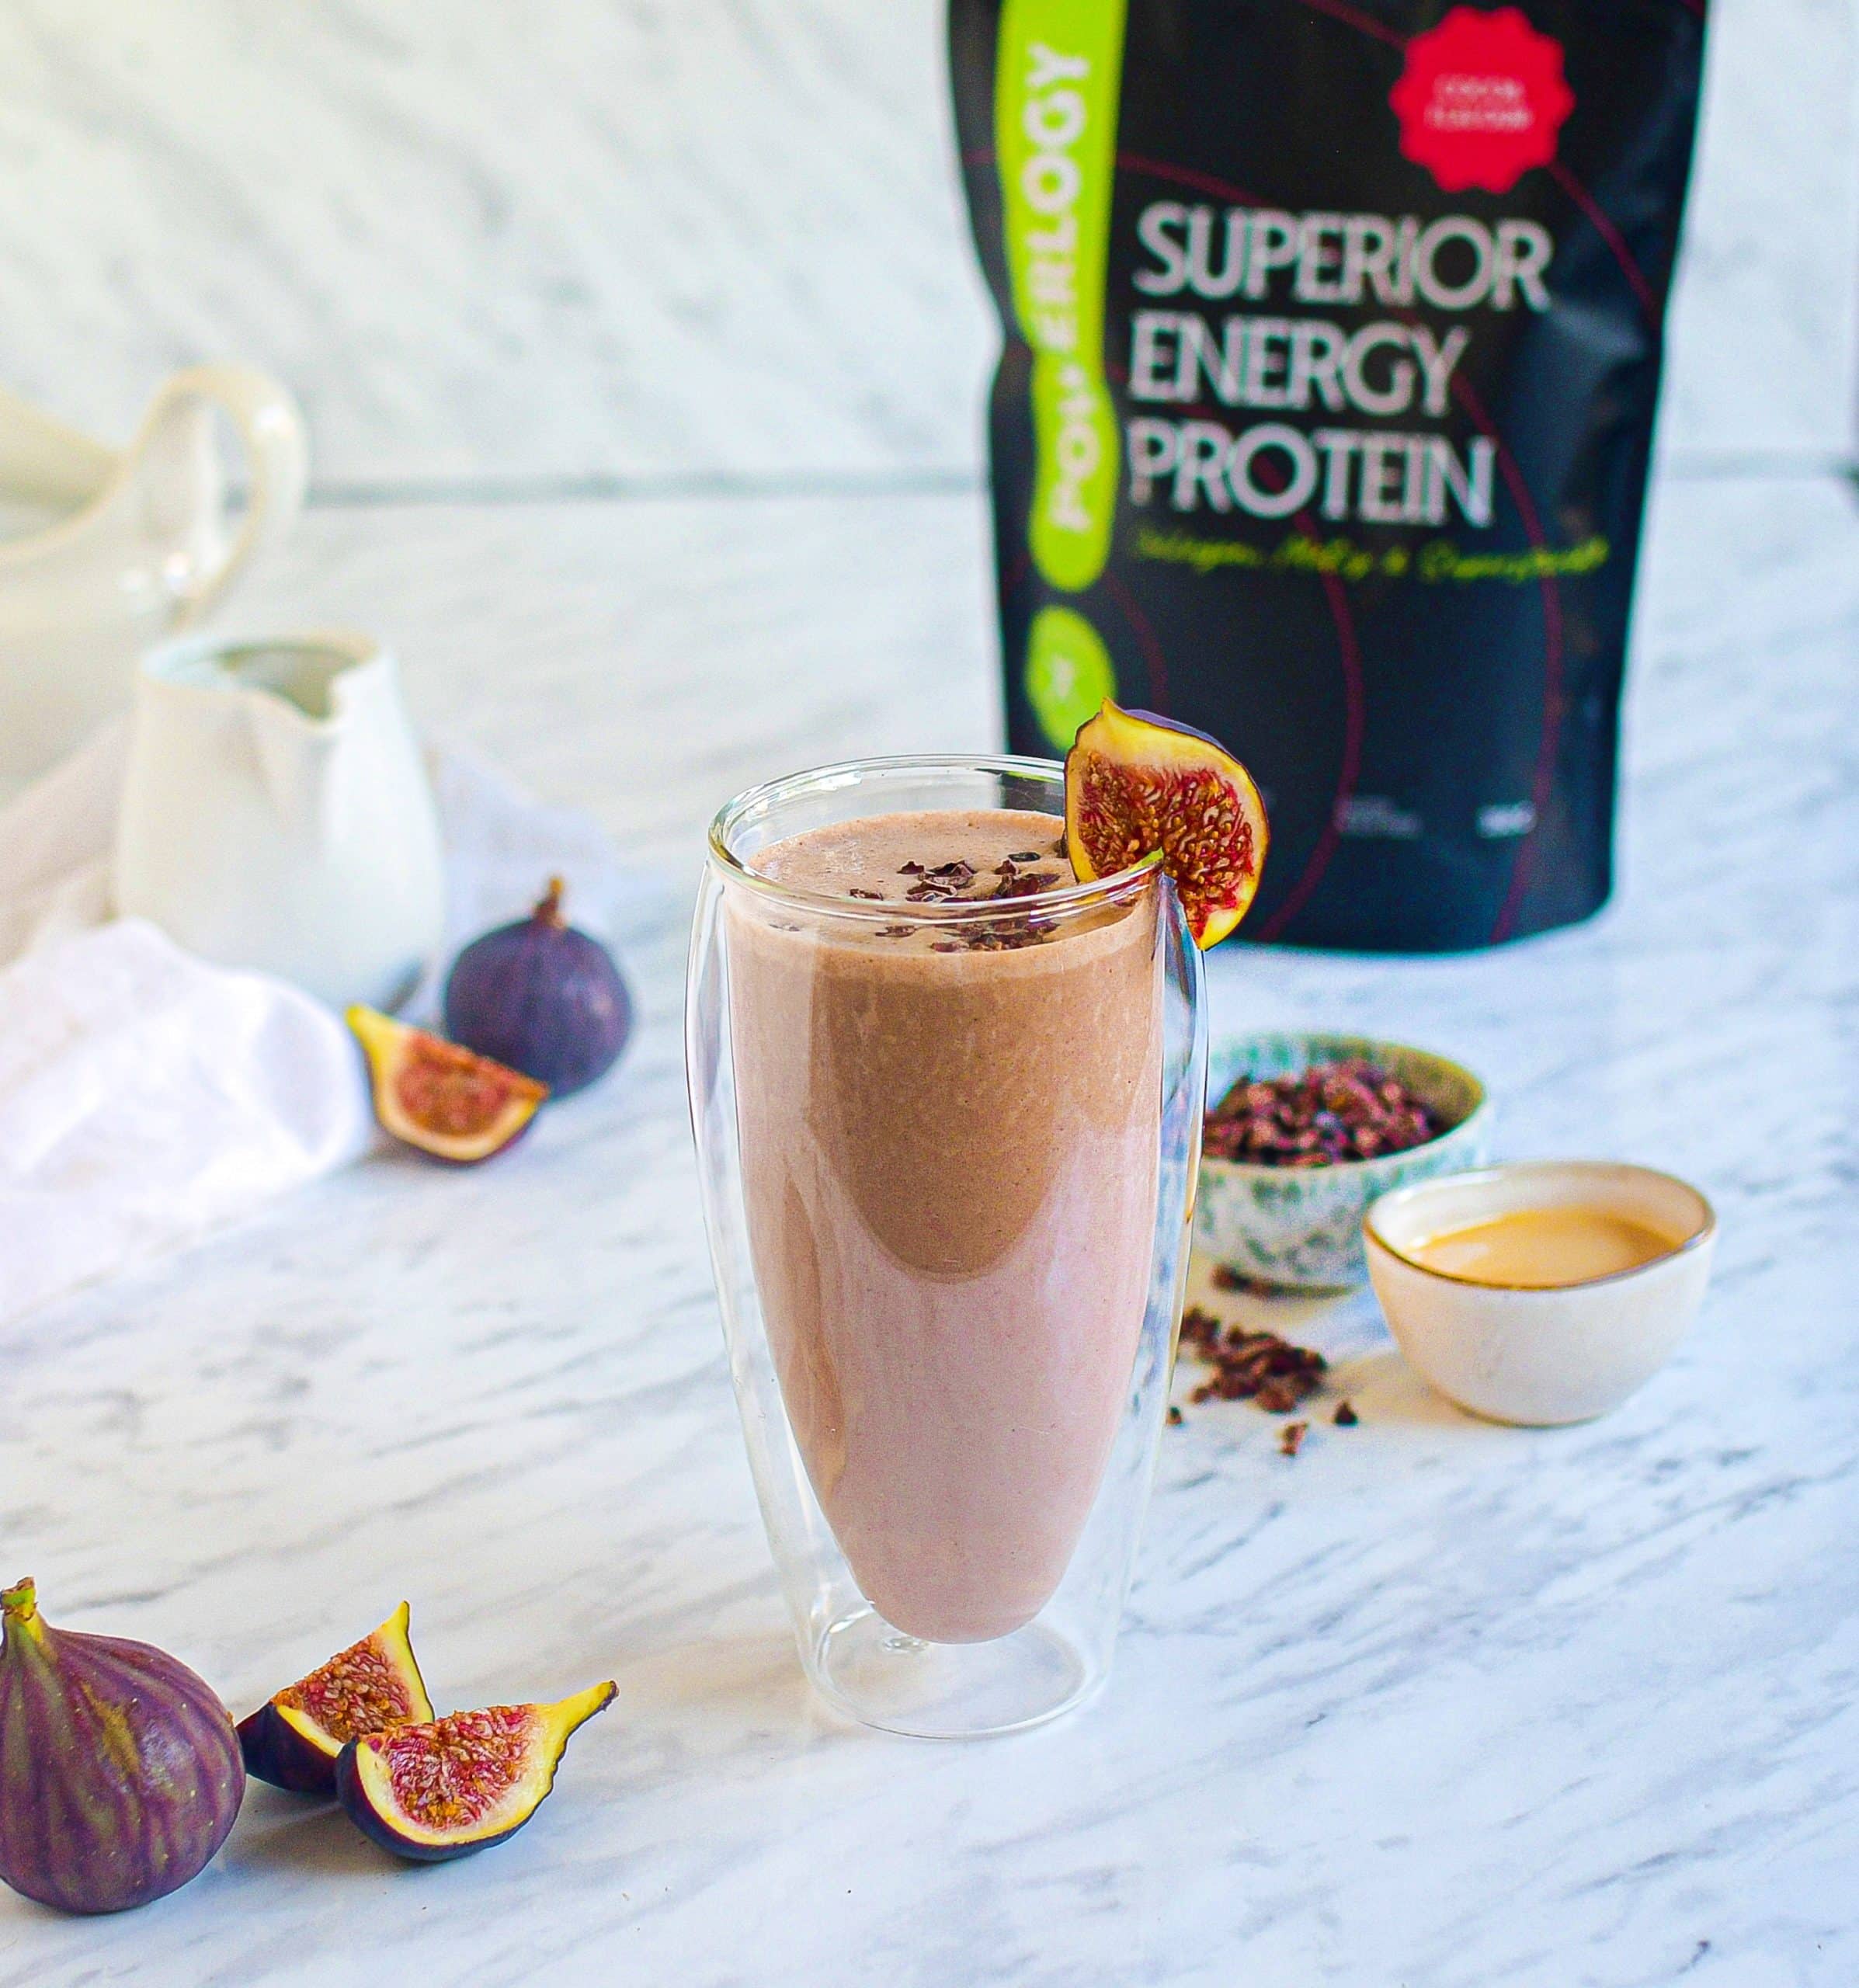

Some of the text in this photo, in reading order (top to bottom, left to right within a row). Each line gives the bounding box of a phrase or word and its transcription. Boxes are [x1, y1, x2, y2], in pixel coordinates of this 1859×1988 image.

[1132, 201, 1553, 313] SUPERIOR
[1129, 310, 1469, 417] ENERGY
[1126, 418, 1496, 527] PROTEIN
